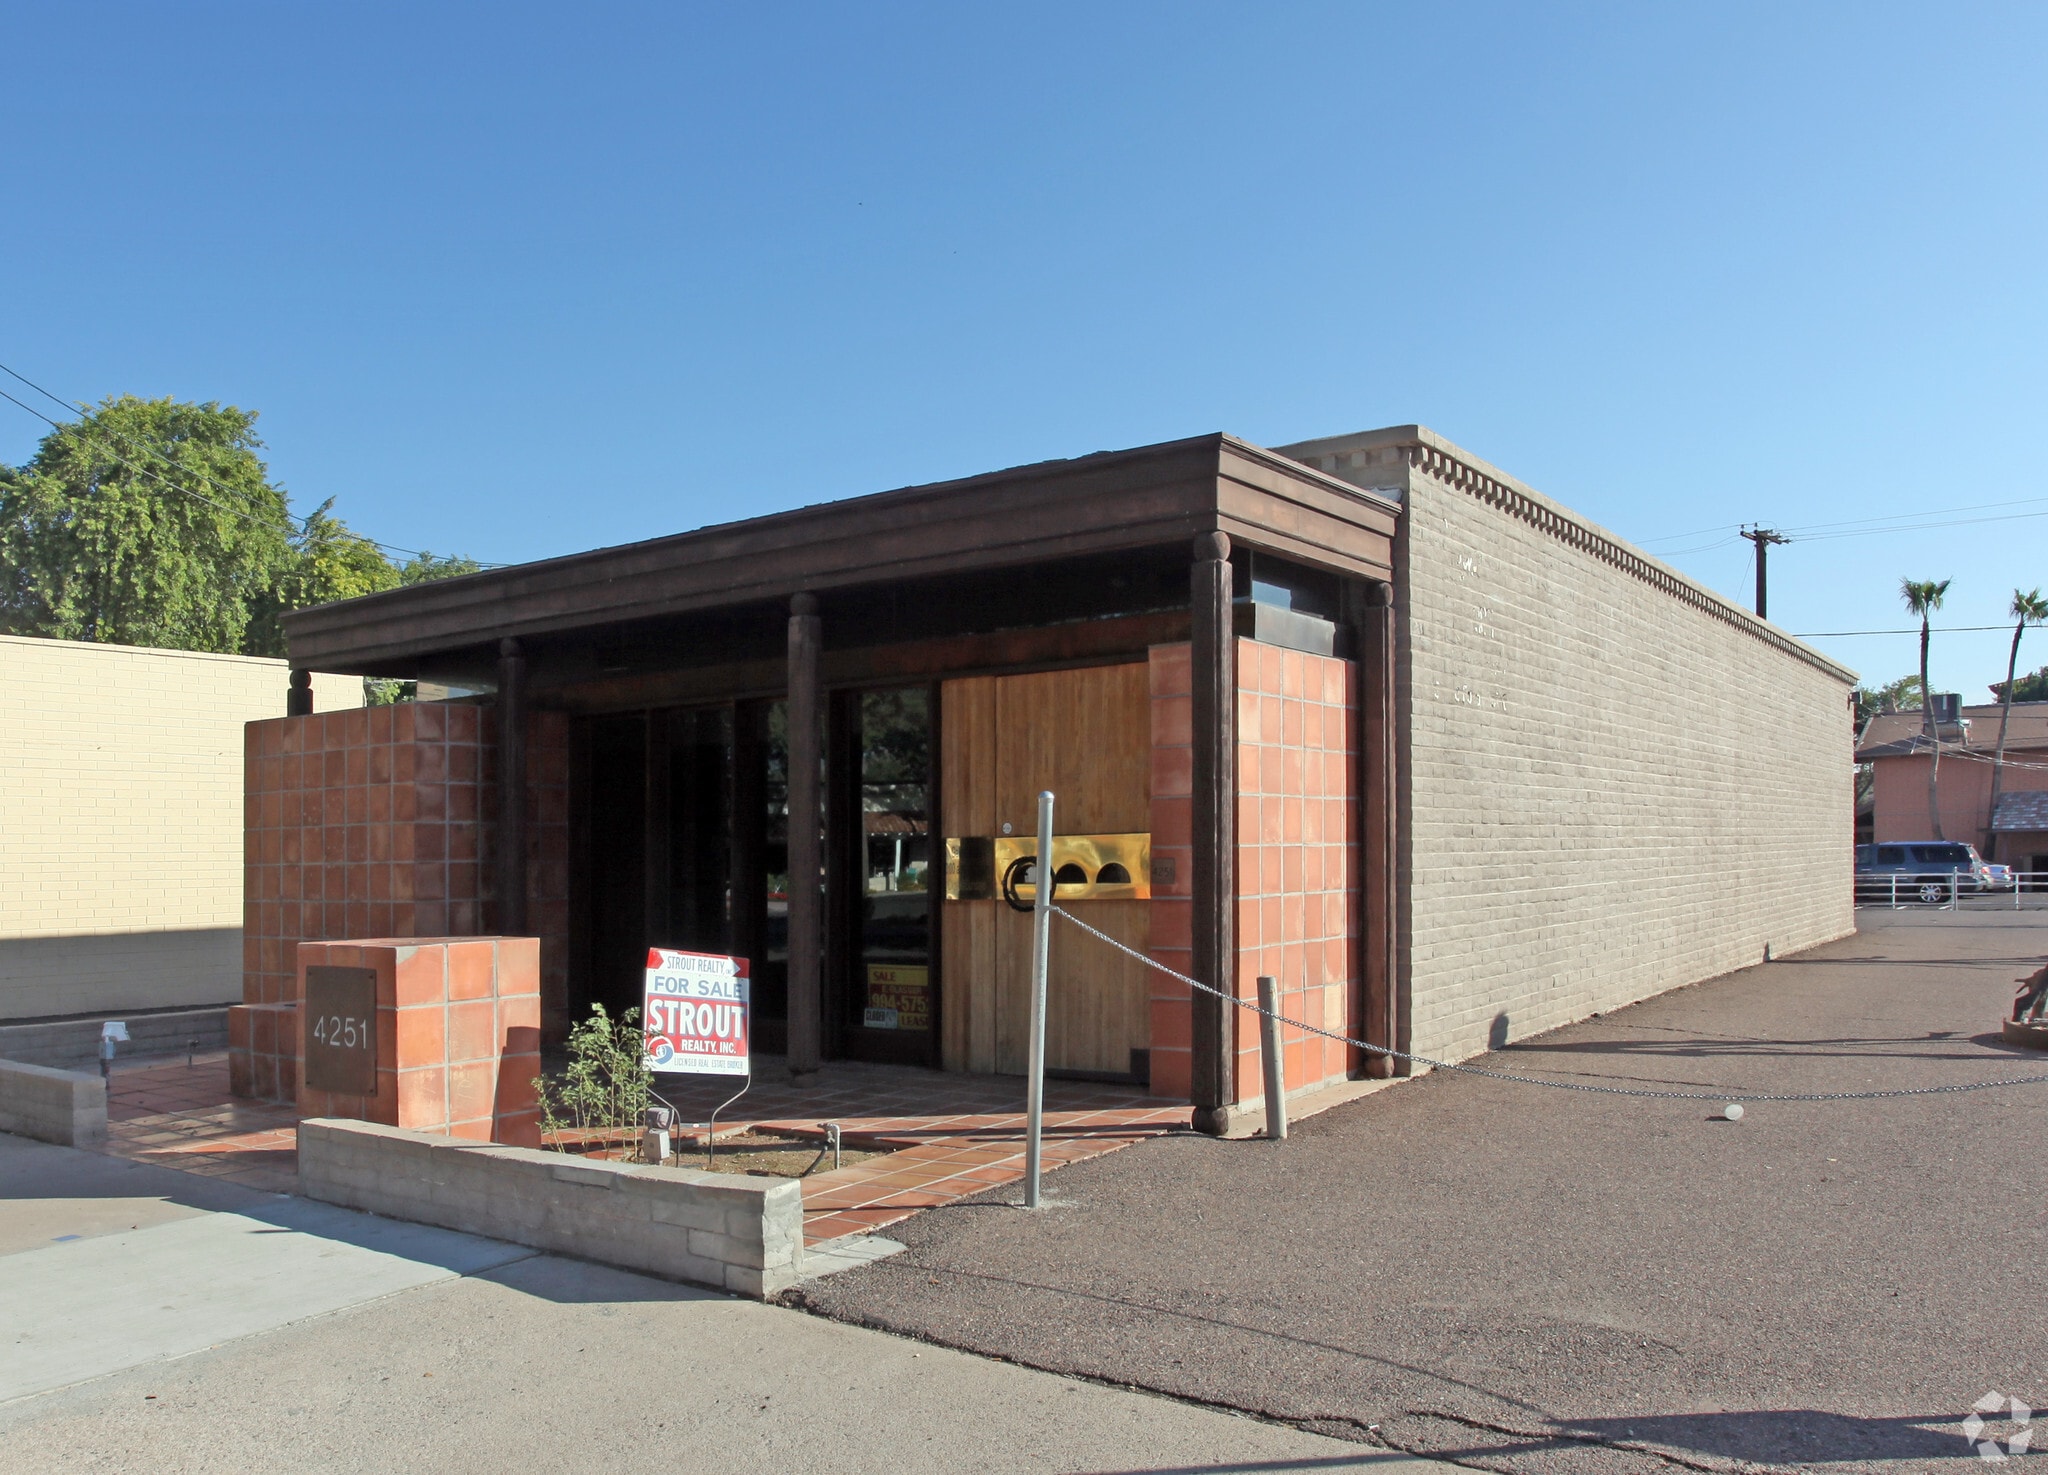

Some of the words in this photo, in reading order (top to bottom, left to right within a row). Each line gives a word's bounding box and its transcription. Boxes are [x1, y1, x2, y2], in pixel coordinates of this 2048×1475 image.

[667, 956, 696, 972] STROUT
[873, 971, 896, 981] SALE
[655, 976, 689, 994] FOR
[698, 980, 742, 998] SALE
[871, 993, 928, 1012] 994-575
[649, 999, 744, 1039] STROUT
[901, 1014, 928, 1025] LEAS
[313, 1015, 367, 1049] 4251
[681, 1039, 717, 1054] REALTY,
[719, 1041, 737, 1054] INC.
[674, 1056, 698, 1068] LICENSED
[698, 1058, 710, 1068] REAL
[711, 1059, 727, 1069] ESTATE
